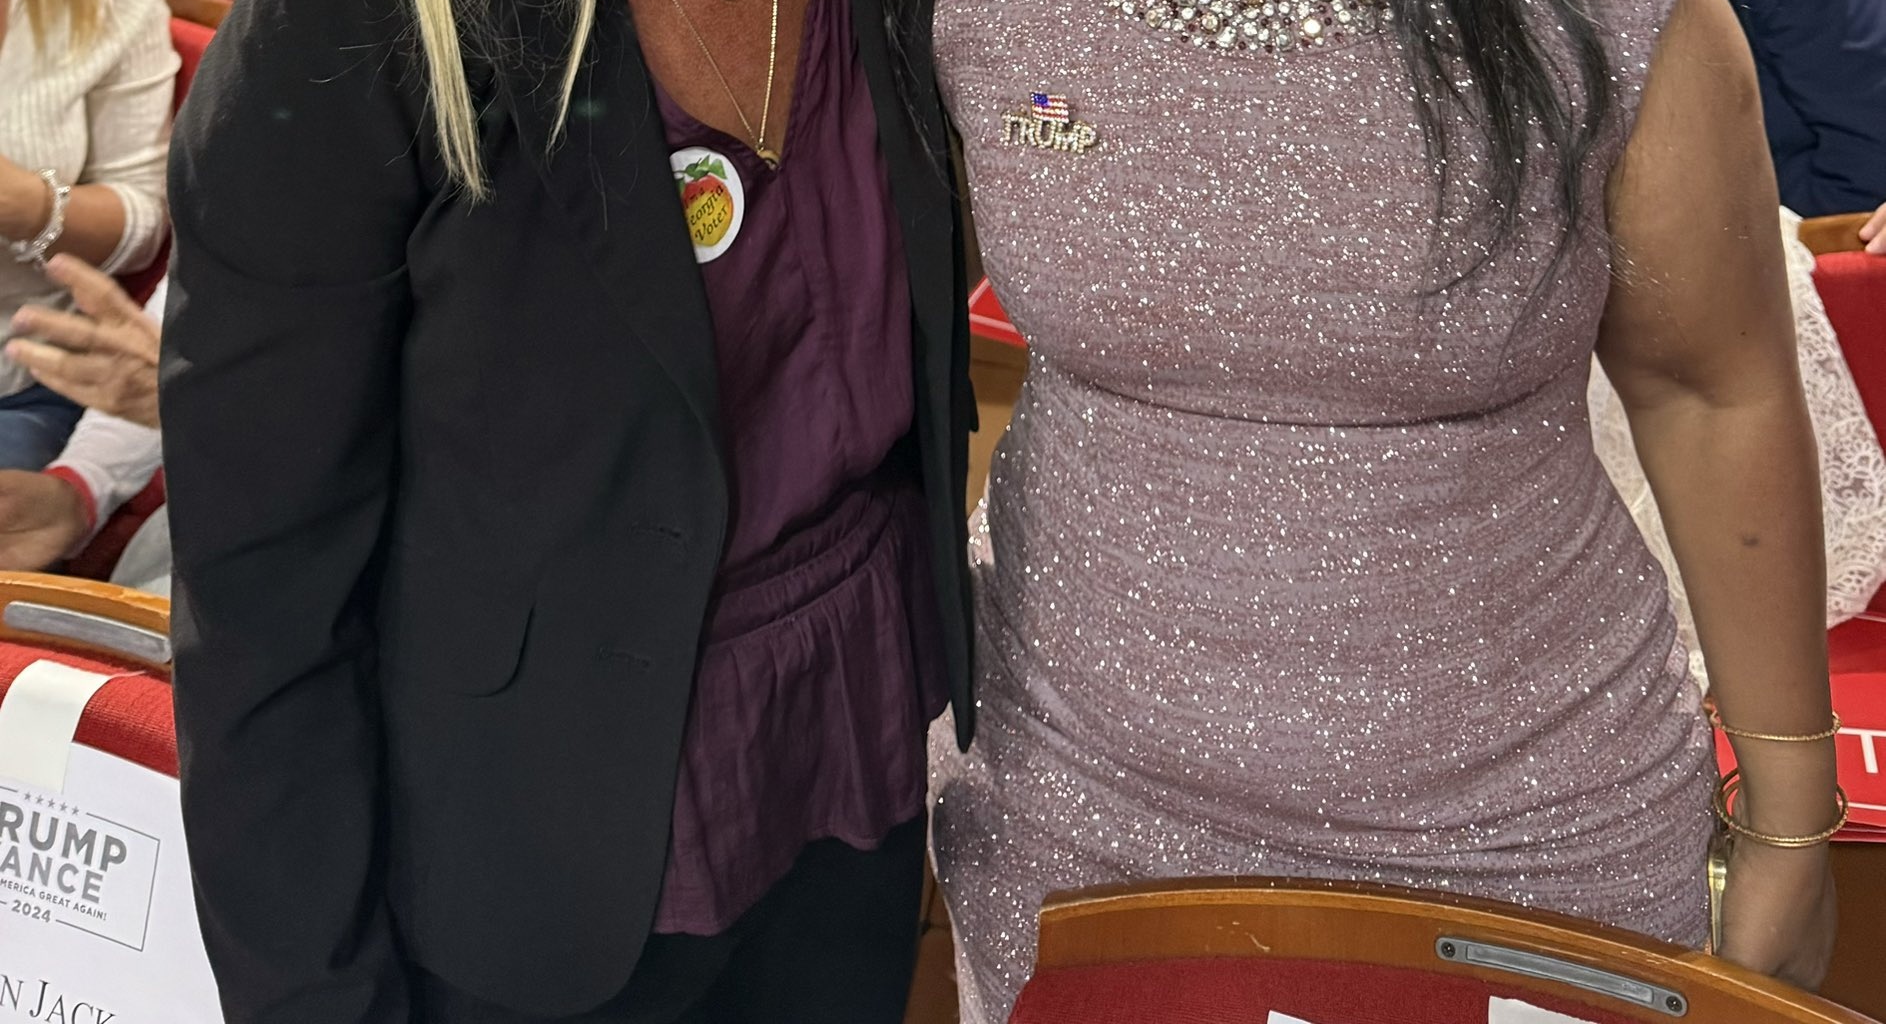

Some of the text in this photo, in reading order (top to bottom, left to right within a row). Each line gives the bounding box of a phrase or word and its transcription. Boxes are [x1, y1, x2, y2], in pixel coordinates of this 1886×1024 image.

[1000, 111, 1097, 155] TRUMP
[690, 184, 725, 226] eorgia
[695, 204, 728, 241] Voter
[0, 801, 127, 873] RUMP
[0, 843, 104, 904] ANCE
[0, 877, 108, 922] MERICA GREAT AGAIN!
[11, 898, 51, 924] 2024
